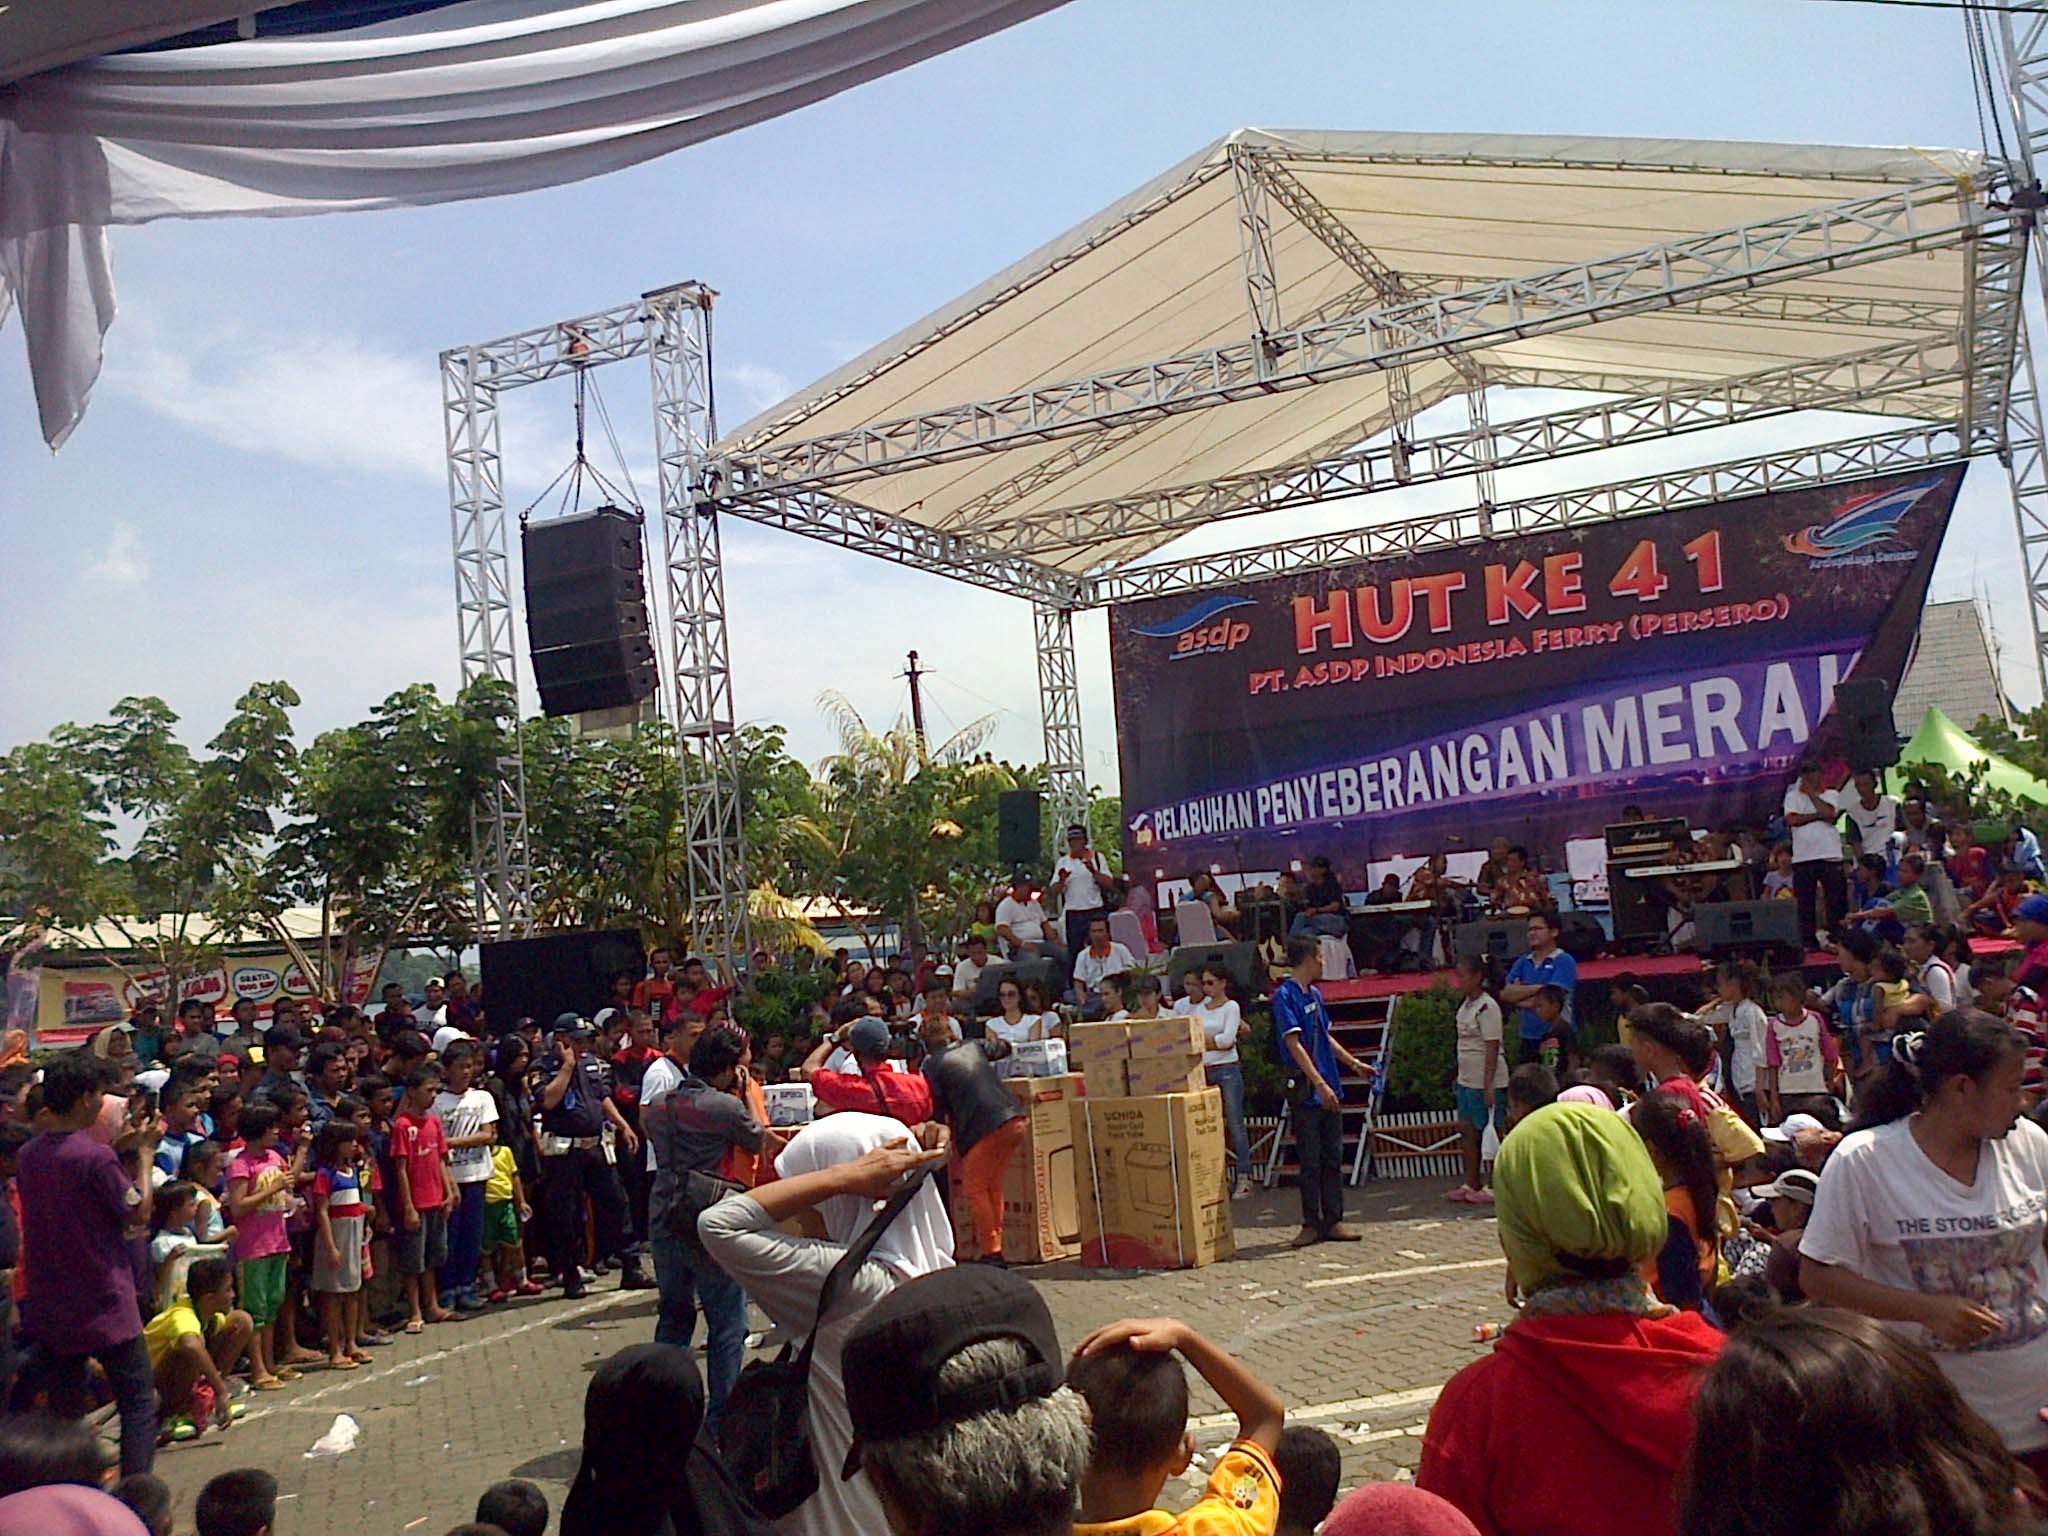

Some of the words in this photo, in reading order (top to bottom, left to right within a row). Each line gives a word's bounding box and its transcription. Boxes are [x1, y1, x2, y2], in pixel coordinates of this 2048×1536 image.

[1293, 571, 1466, 654] HUT
[1484, 552, 1587, 626] KE
[1177, 617, 1250, 652] asdp
[1249, 669, 1289, 695] PT.
[1293, 658, 1370, 689] ASDP
[1154, 789, 1252, 841] PELABUHAN
[1257, 713, 1569, 828] PENYEBERANGAN
[1104, 1109, 1144, 1122] UCHIDA
[1896, 1217, 1931, 1235] THE
[1935, 1213, 1998, 1233] STONE
